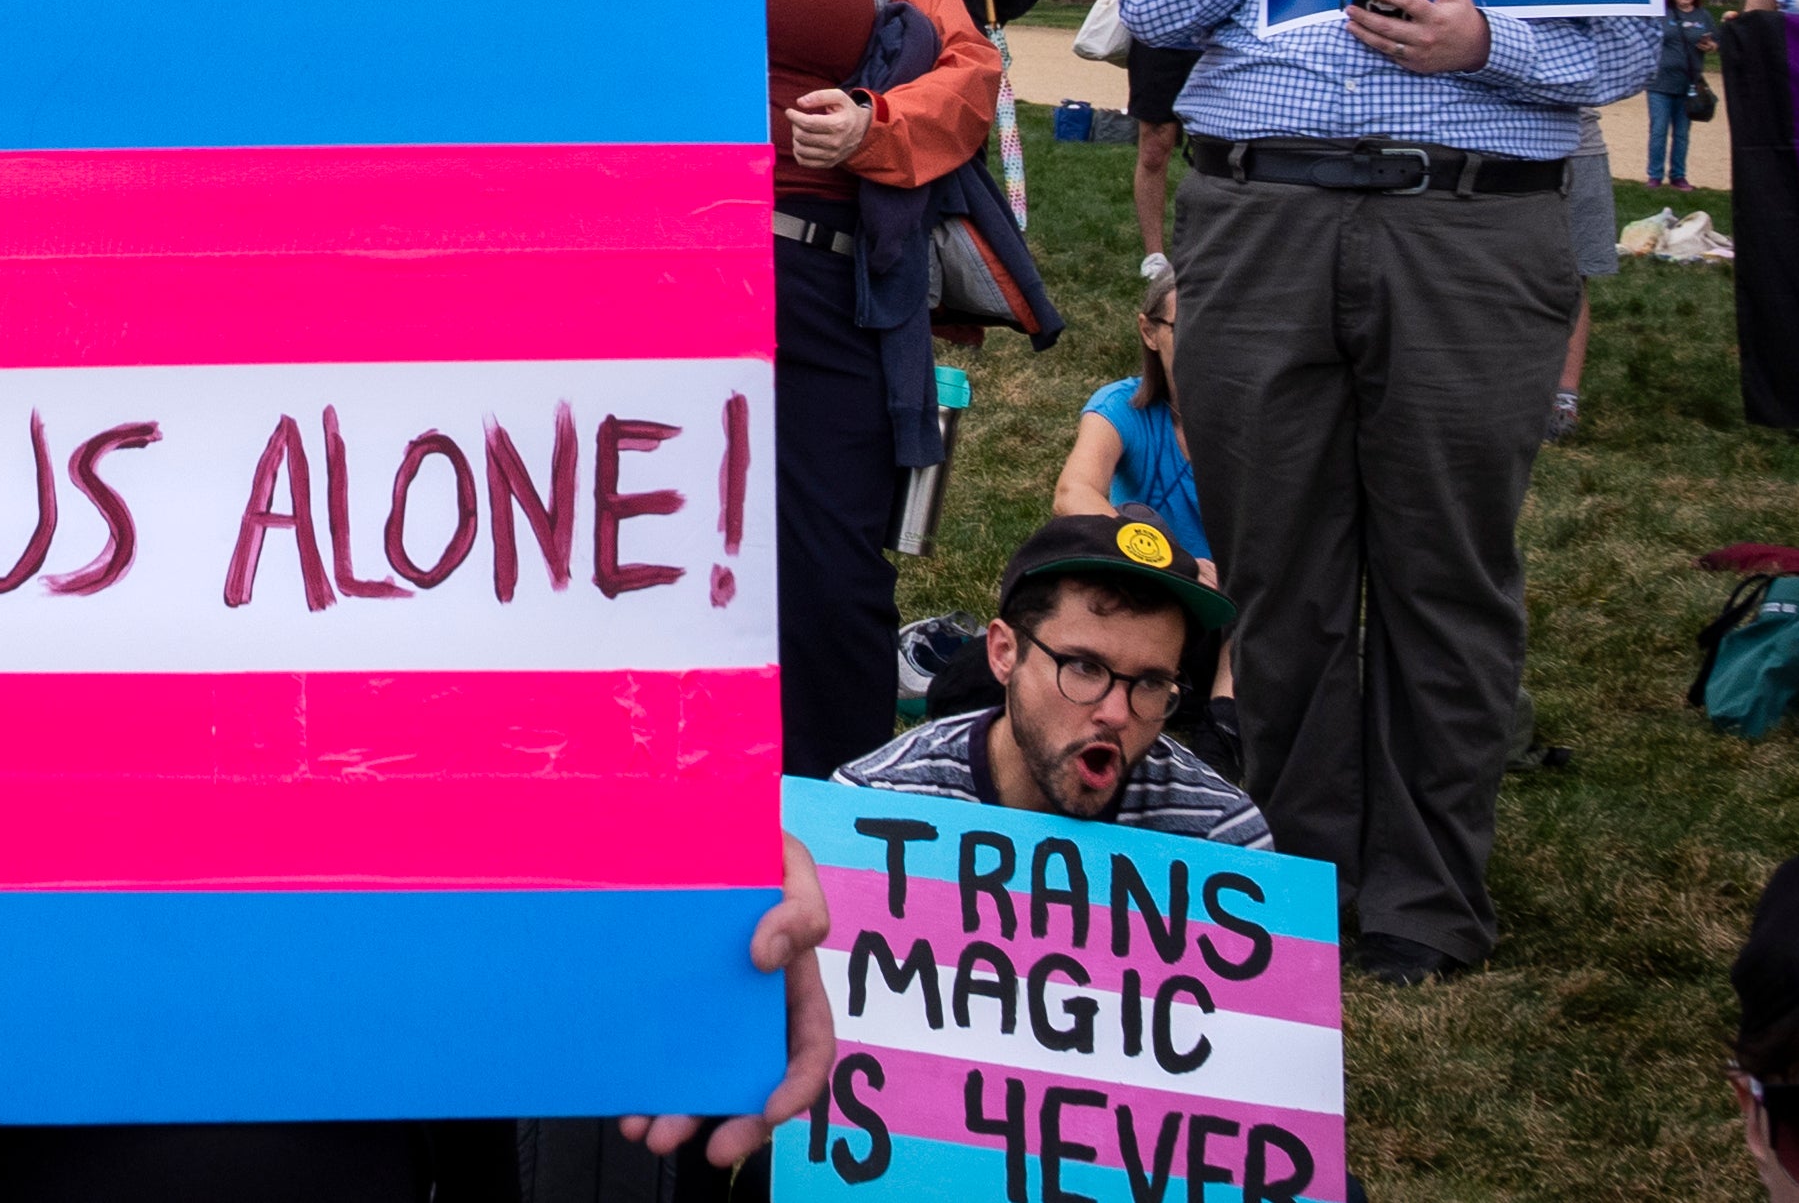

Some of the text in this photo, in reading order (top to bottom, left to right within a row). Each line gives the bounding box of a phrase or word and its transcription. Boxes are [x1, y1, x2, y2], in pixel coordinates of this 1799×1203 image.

[223, 390, 752, 612] ALONE!
[855, 817, 1273, 981] TRANS
[848, 930, 1215, 1074] MAGIC
[807, 1052, 1314, 1203] IS 4EVER
